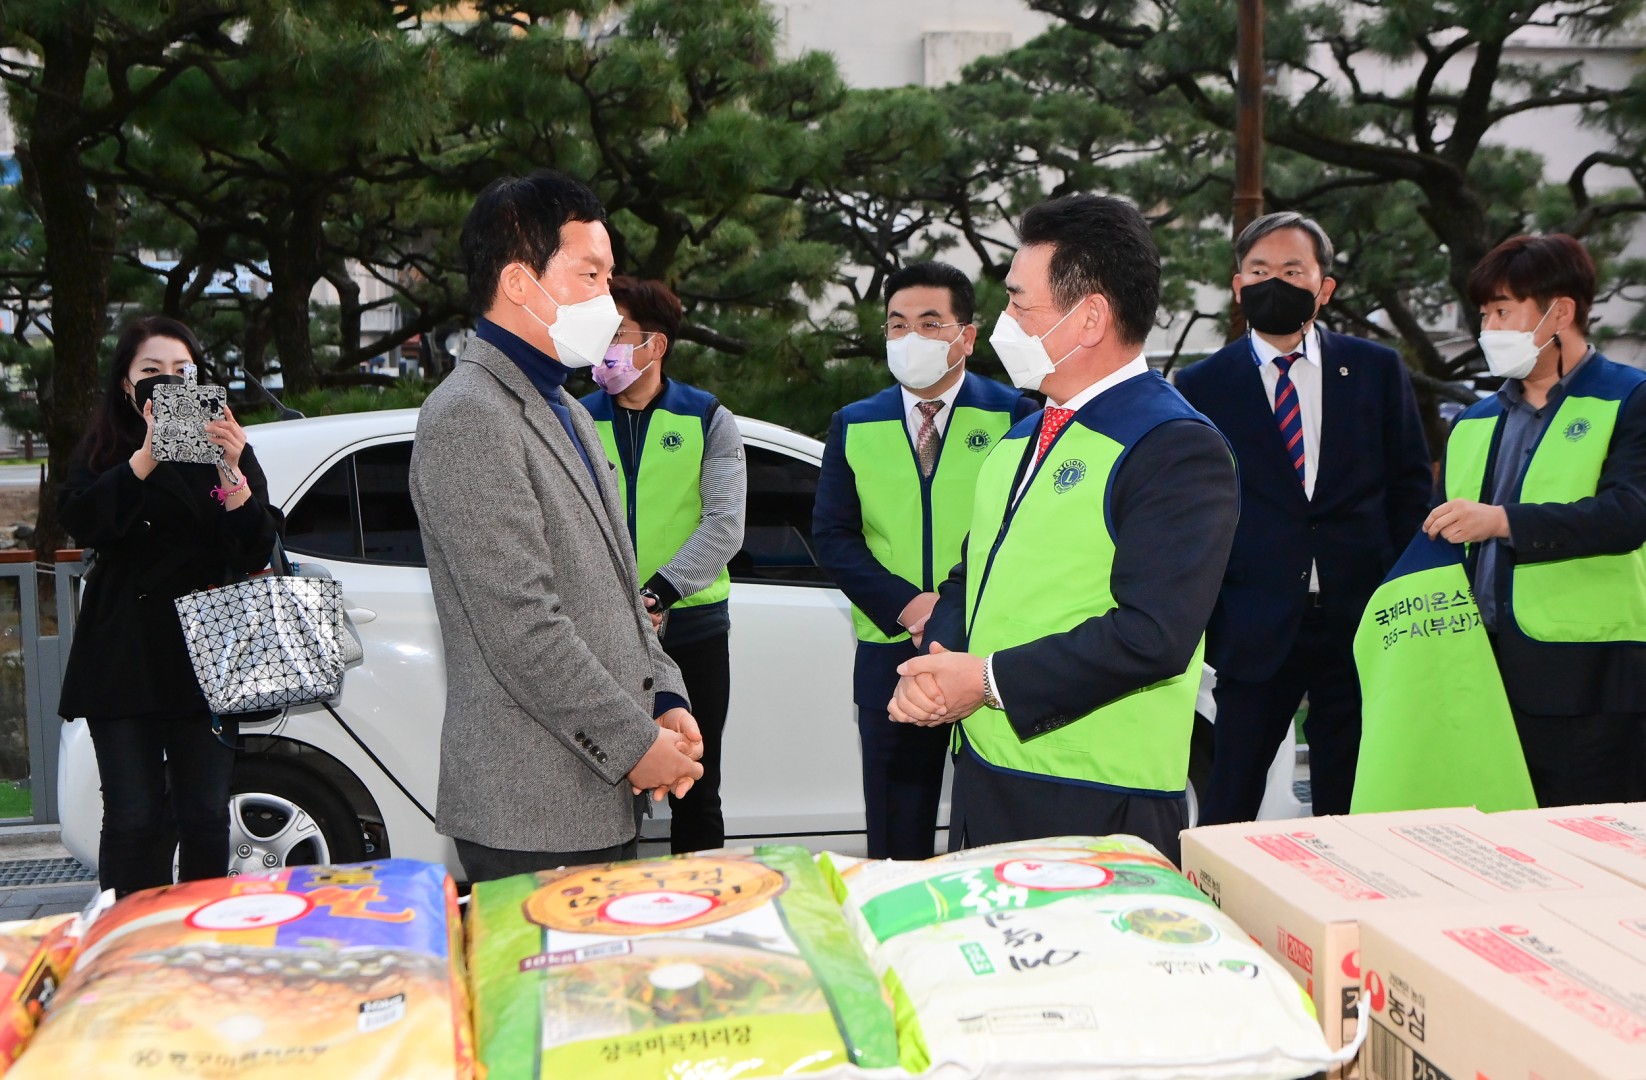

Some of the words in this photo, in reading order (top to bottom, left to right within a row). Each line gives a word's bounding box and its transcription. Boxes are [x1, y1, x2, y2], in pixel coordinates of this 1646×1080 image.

[1065, 460, 1085, 471] LIONS
[1064, 470, 1074, 483] L
[1388, 989, 1425, 1042] 농심
